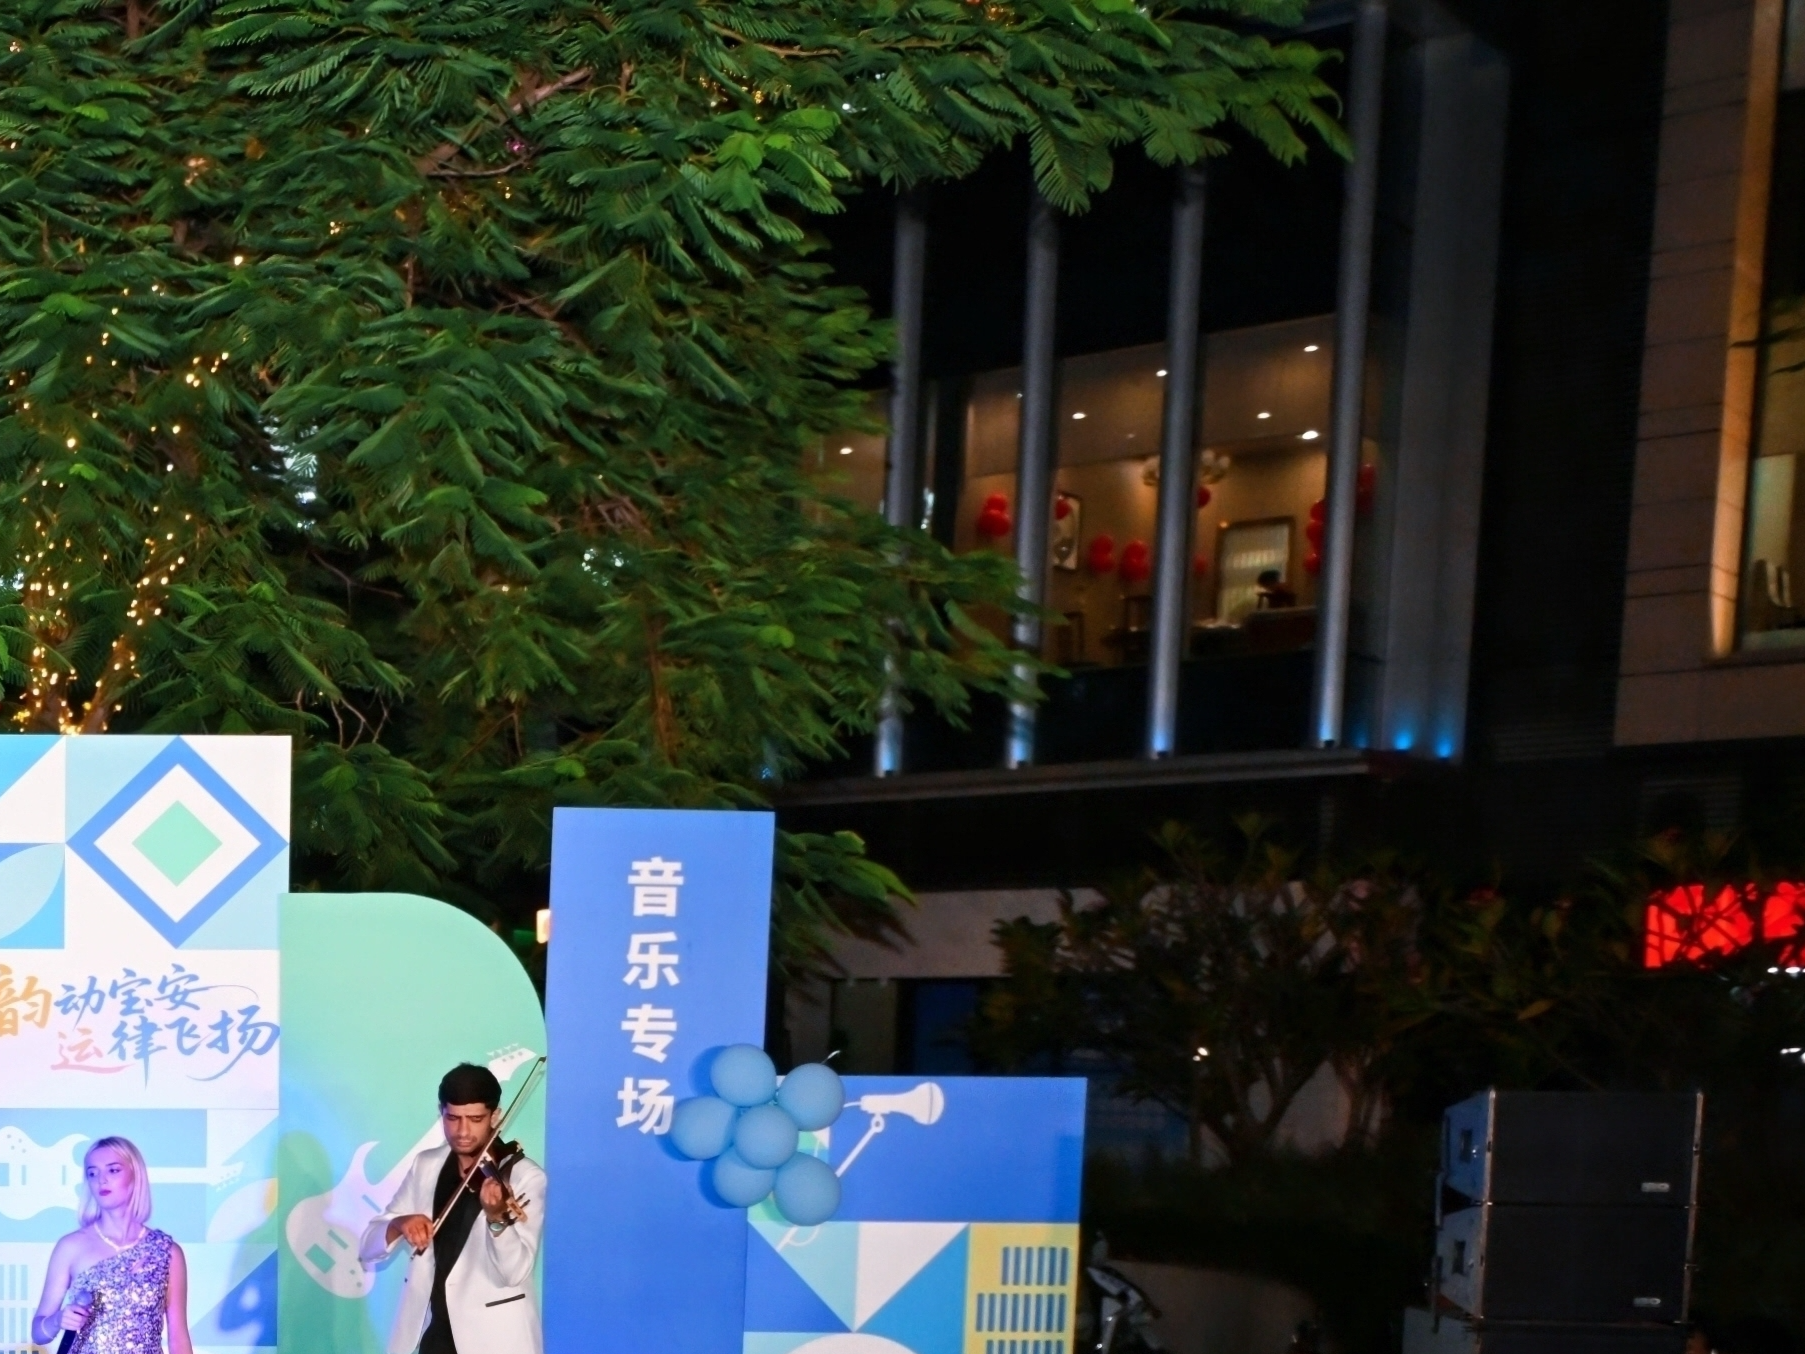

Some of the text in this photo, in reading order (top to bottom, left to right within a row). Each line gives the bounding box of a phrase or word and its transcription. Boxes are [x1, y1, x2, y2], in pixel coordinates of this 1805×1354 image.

[50, 1005, 281, 1090] 运律飞扬
[616, 857, 684, 1135] 音乐专场
